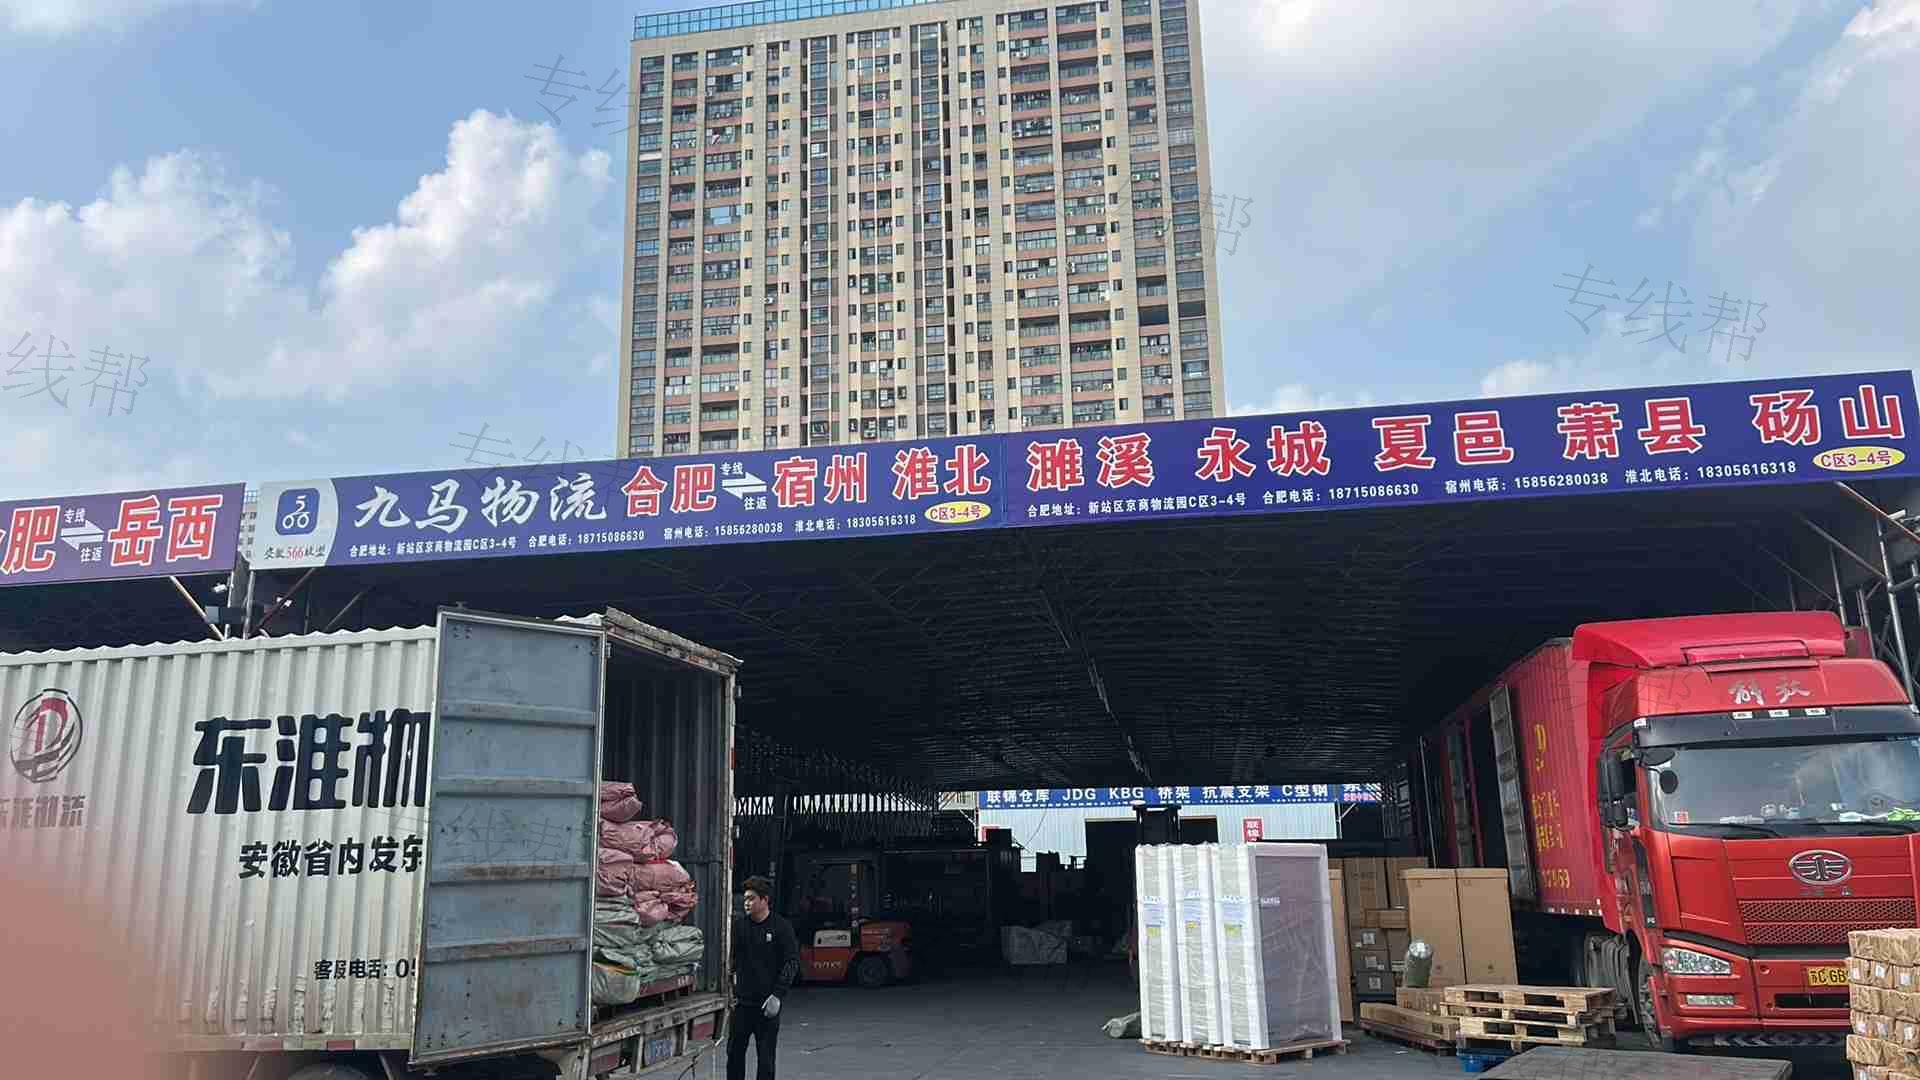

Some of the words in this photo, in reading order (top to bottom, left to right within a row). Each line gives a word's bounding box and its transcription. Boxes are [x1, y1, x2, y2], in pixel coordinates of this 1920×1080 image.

[1027, 432, 1154, 491] 濉溪
[1195, 421, 1331, 481] 永城
[1372, 411, 1514, 472] 夏邑
[1557, 396, 1706, 461] 萧县
[1750, 385, 1905, 446] 砀山
[1821, 451, 1892, 468] C区3-4号
[353, 472, 607, 533] 九马物流
[621, 464, 717, 518] 合肥
[772, 452, 867, 507] 宿州
[891, 444, 992, 500] 淮北
[107, 495, 223, 567] 岳西
[930, 504, 982, 521] C区3-4号
[0, 505, 61, 575] 肥
[1062, 788, 1096, 800] JDG
[1109, 787, 1144, 799] KBG
[1158, 786, 1190, 800] 桥架
[1202, 785, 1270, 799] 抗震支架
